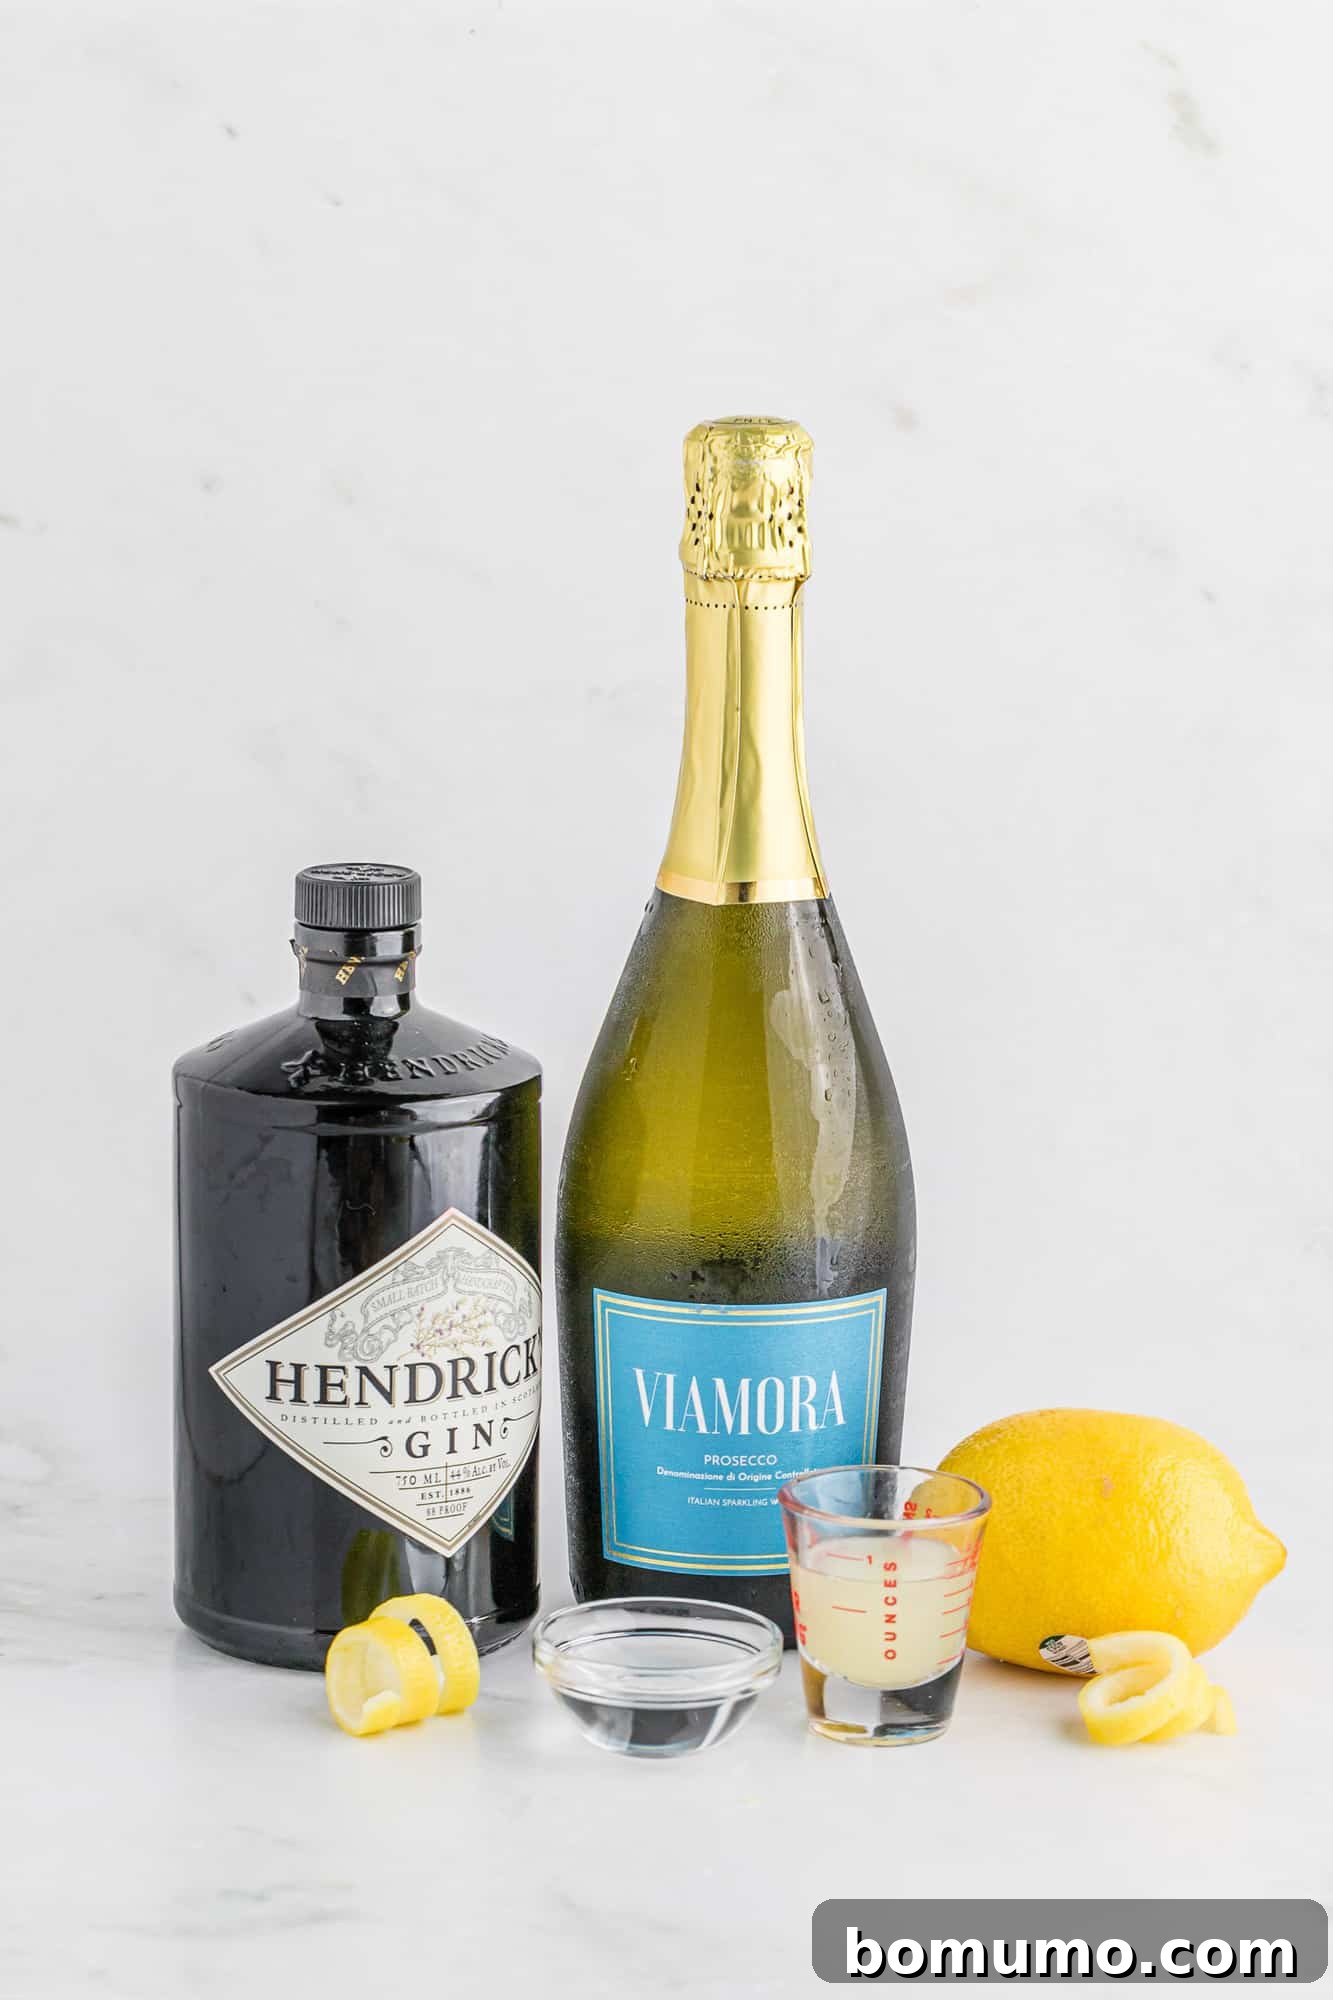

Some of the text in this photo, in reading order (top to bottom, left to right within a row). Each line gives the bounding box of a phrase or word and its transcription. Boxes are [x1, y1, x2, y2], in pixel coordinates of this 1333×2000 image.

[370, 1289, 405, 1312] SMALL
[632, 1368, 847, 1436] VIAMORA
[280, 1413, 378, 1426] DISTILLED
[419, 1406, 488, 1423] BOTTLED
[405, 1419, 494, 1459] GIN
[703, 1454, 778, 1467] PROSECCO
[423, 1471, 441, 1485] ML
[656, 1466, 724, 1482] Denominazione
[726, 1471, 736, 1481] di
[738, 1471, 772, 1483] Origine
[420, 1491, 444, 1500] EST.
[687, 1495, 720, 1506] ITALIAN
[722, 1497, 768, 1507] SPARKLING
[439, 1502, 467, 1516] PROOF
[883, 1561, 897, 1661] OUNCES
